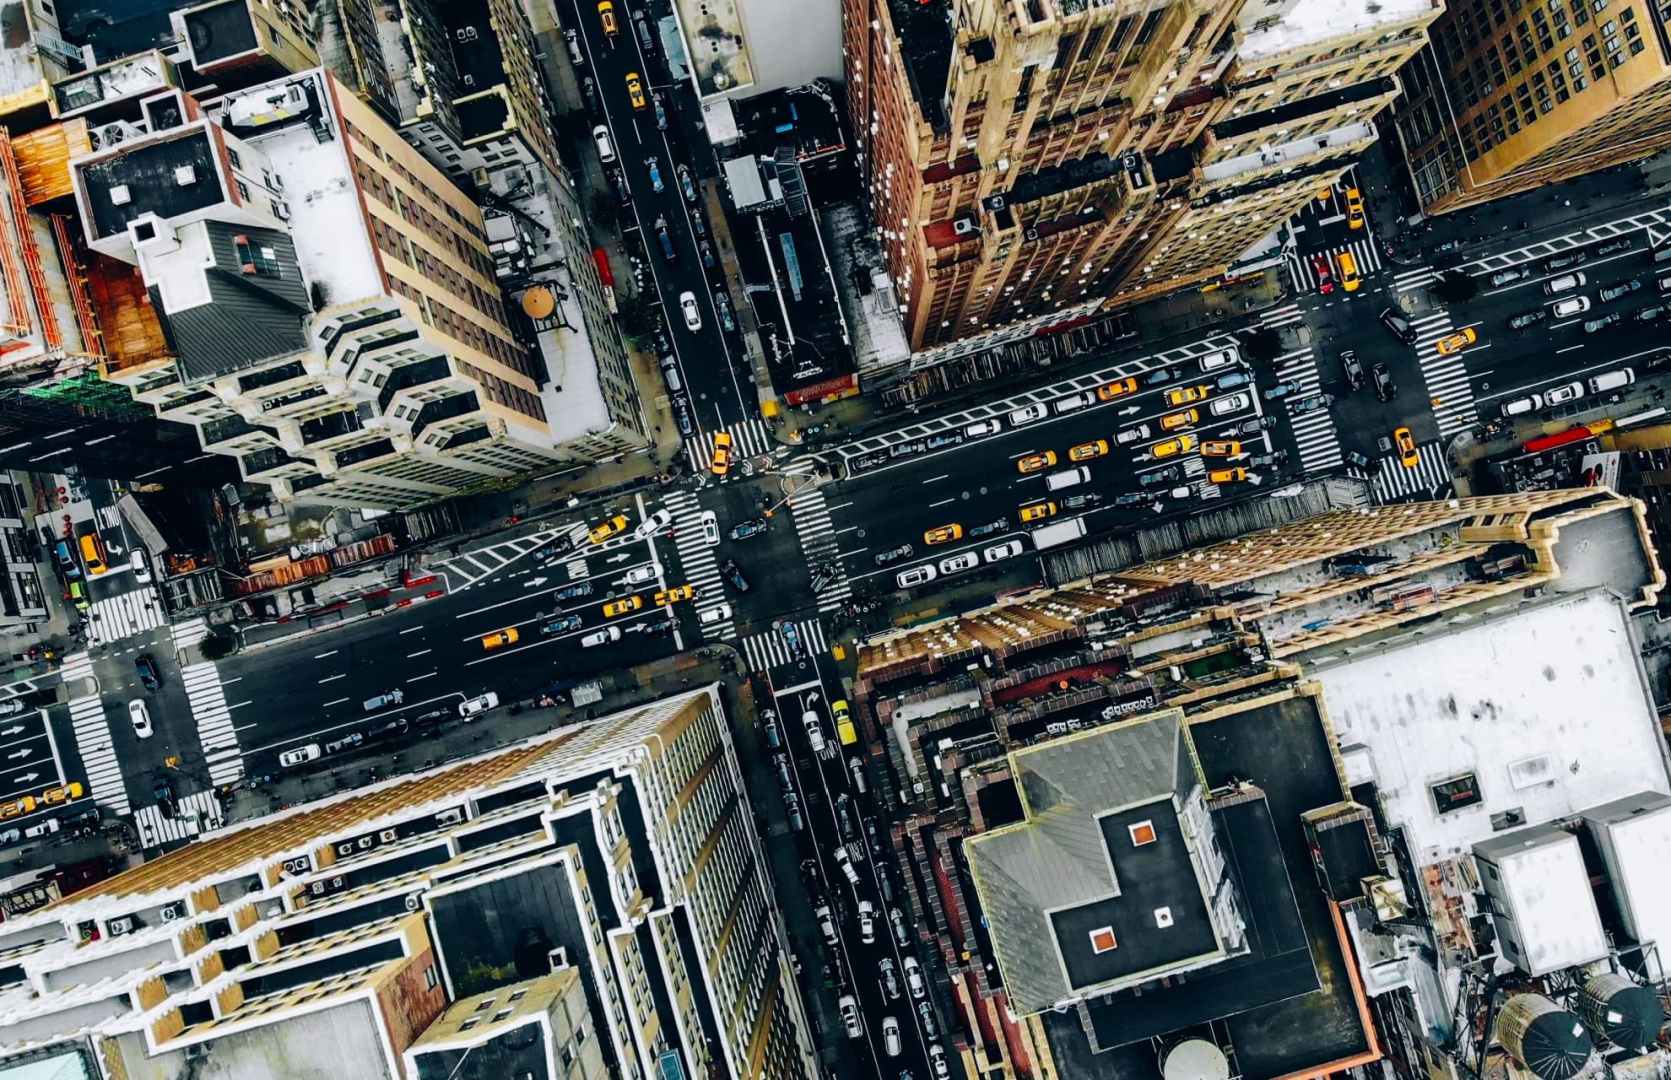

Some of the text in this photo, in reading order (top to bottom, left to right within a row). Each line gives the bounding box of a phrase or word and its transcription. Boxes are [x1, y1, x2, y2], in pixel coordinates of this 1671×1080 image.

[1183, 457, 1207, 478] ONLY
[96, 505, 120, 530] ONLY
[566, 559, 590, 579] ONLY
